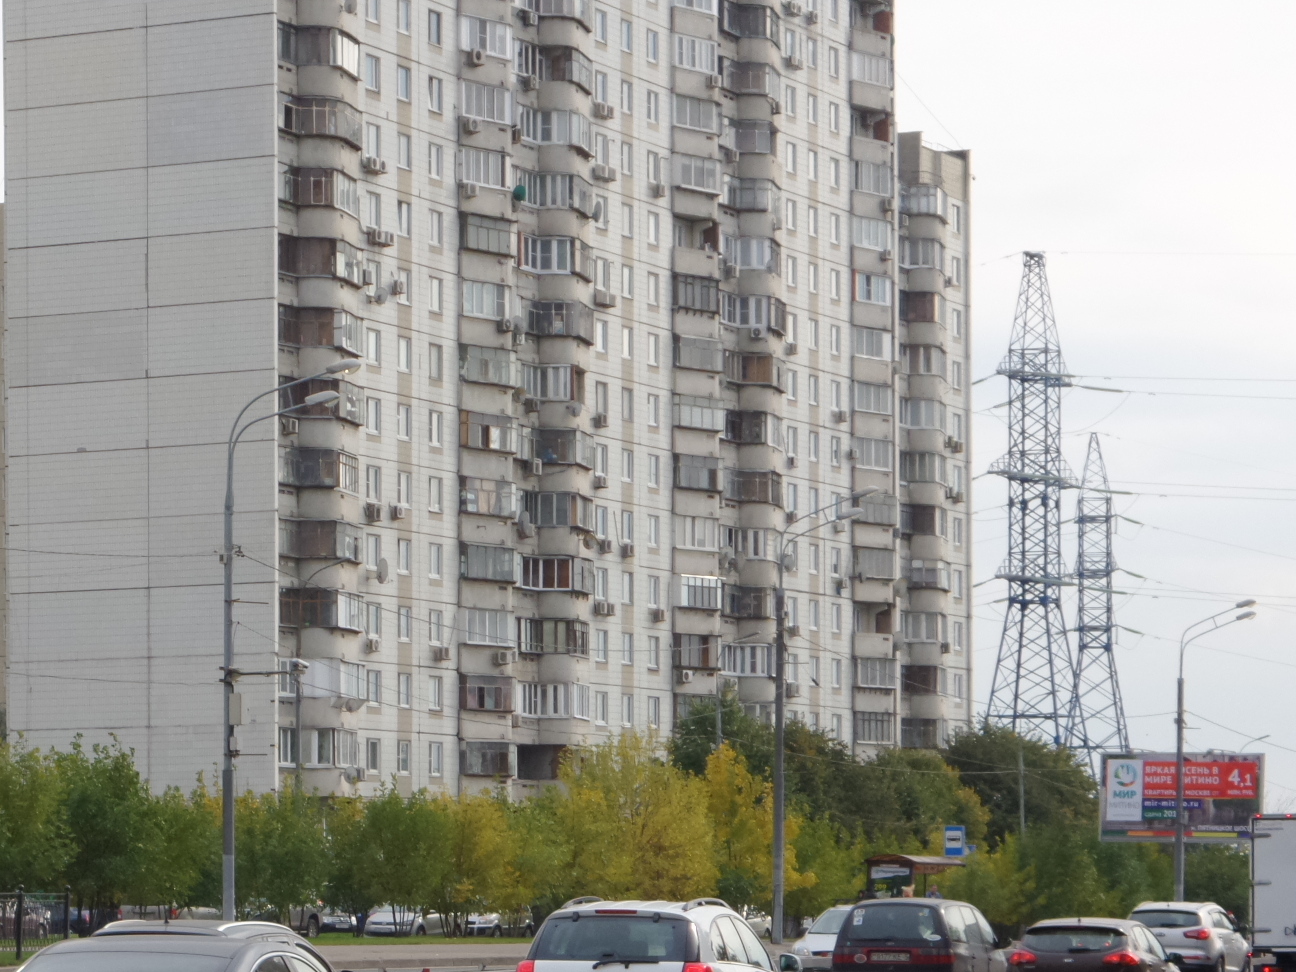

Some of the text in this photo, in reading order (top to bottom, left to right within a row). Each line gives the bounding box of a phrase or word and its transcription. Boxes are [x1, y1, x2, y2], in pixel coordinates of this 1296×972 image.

[1145, 766, 1176, 774] ЯРКАЯ
[1144, 775, 1220, 785] МИРЕ ИТИНО
[1227, 768, 1253, 788] 4,1
[1113, 790, 1137, 799] МИР
